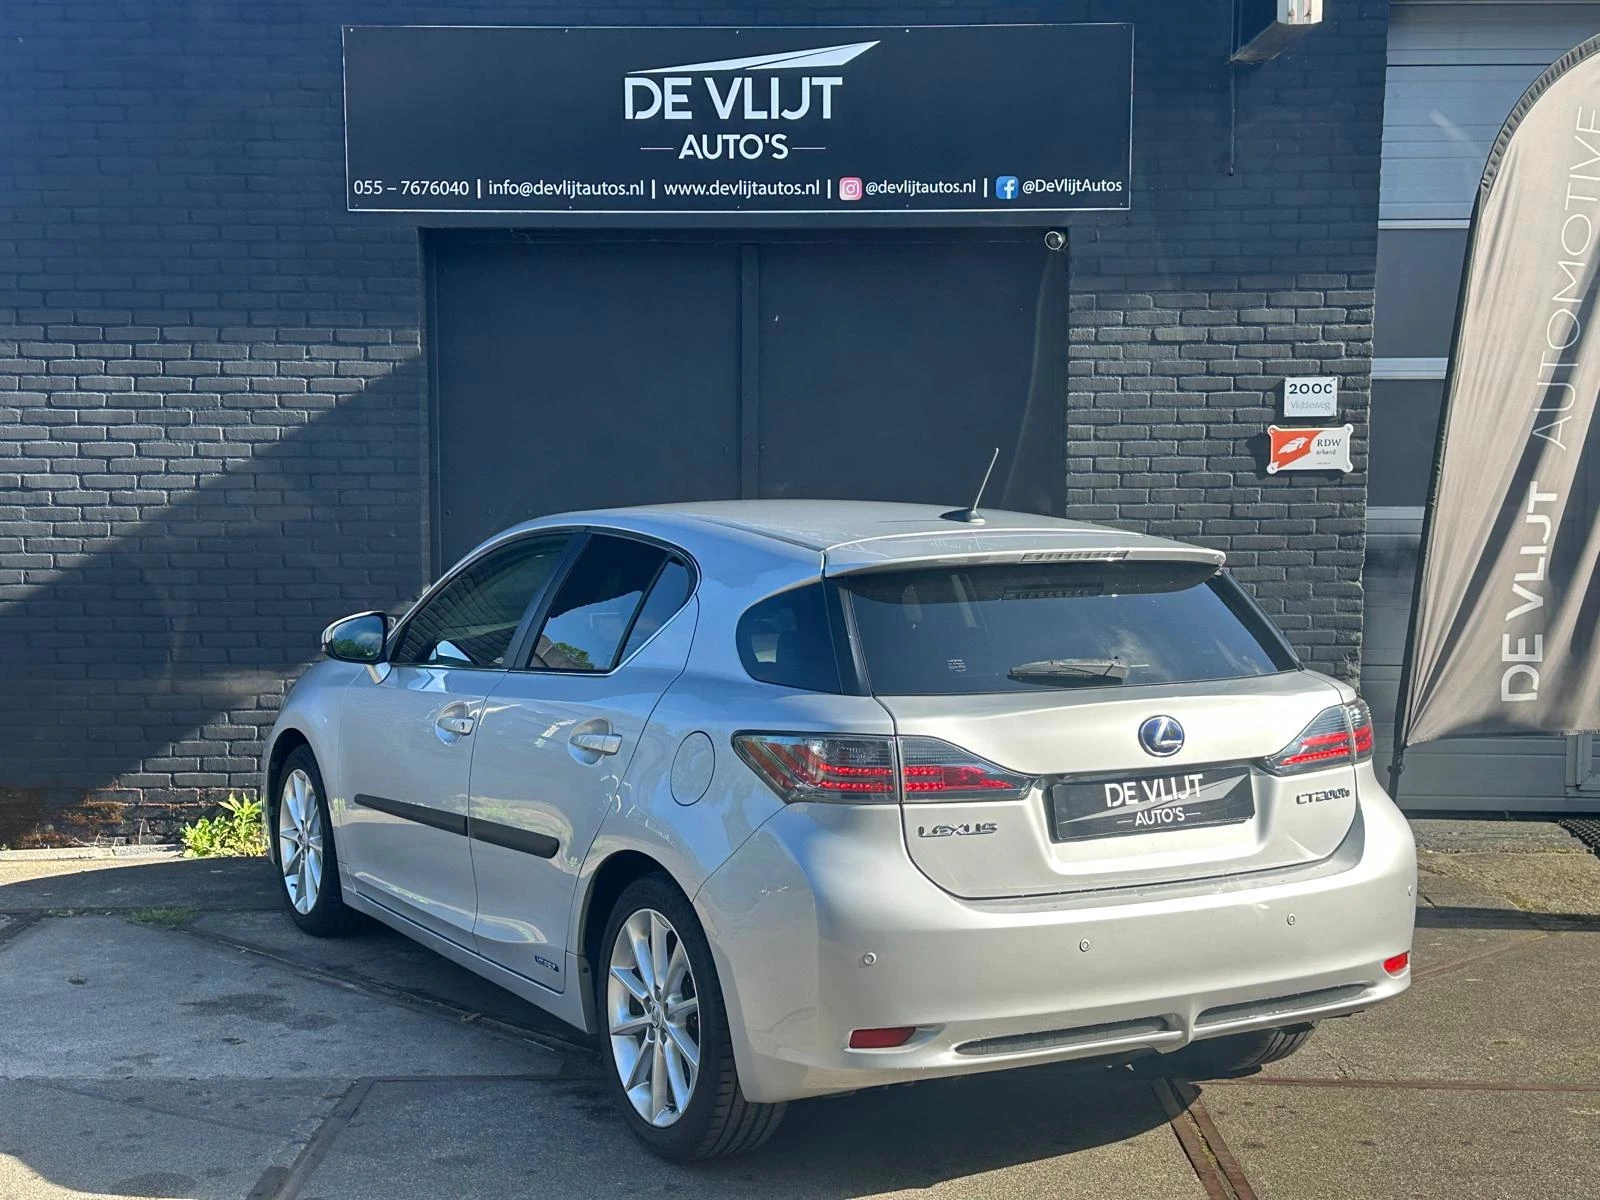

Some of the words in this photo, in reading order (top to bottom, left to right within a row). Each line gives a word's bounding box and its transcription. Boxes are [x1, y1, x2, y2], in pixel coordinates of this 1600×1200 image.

[624, 77, 693, 120] DE
[704, 76, 843, 121] VLIJT
[678, 133, 789, 160] AUTO'S
[353, 180, 383, 196] 055
[401, 180, 470, 196] 7676040
[488, 179, 645, 199] info@devlijtautos.nl
[664, 179, 820, 199] www.devlijtautos.nl
[865, 178, 977, 198] @devlijtautos.nl
[1022, 178, 1123, 196] @DeVlijtAutos
[1532, 105, 1600, 451] AUTOMOTIVE
[1316, 438, 1342, 447] RDW
[1505, 480, 1558, 622] VLIJT
[1501, 634, 1543, 702] DE
[1104, 782, 1139, 808] DE
[1141, 774, 1204, 803] VLIJT
[918, 822, 998, 838] LEXUS
[1135, 807, 1186, 827] AUTO'S
